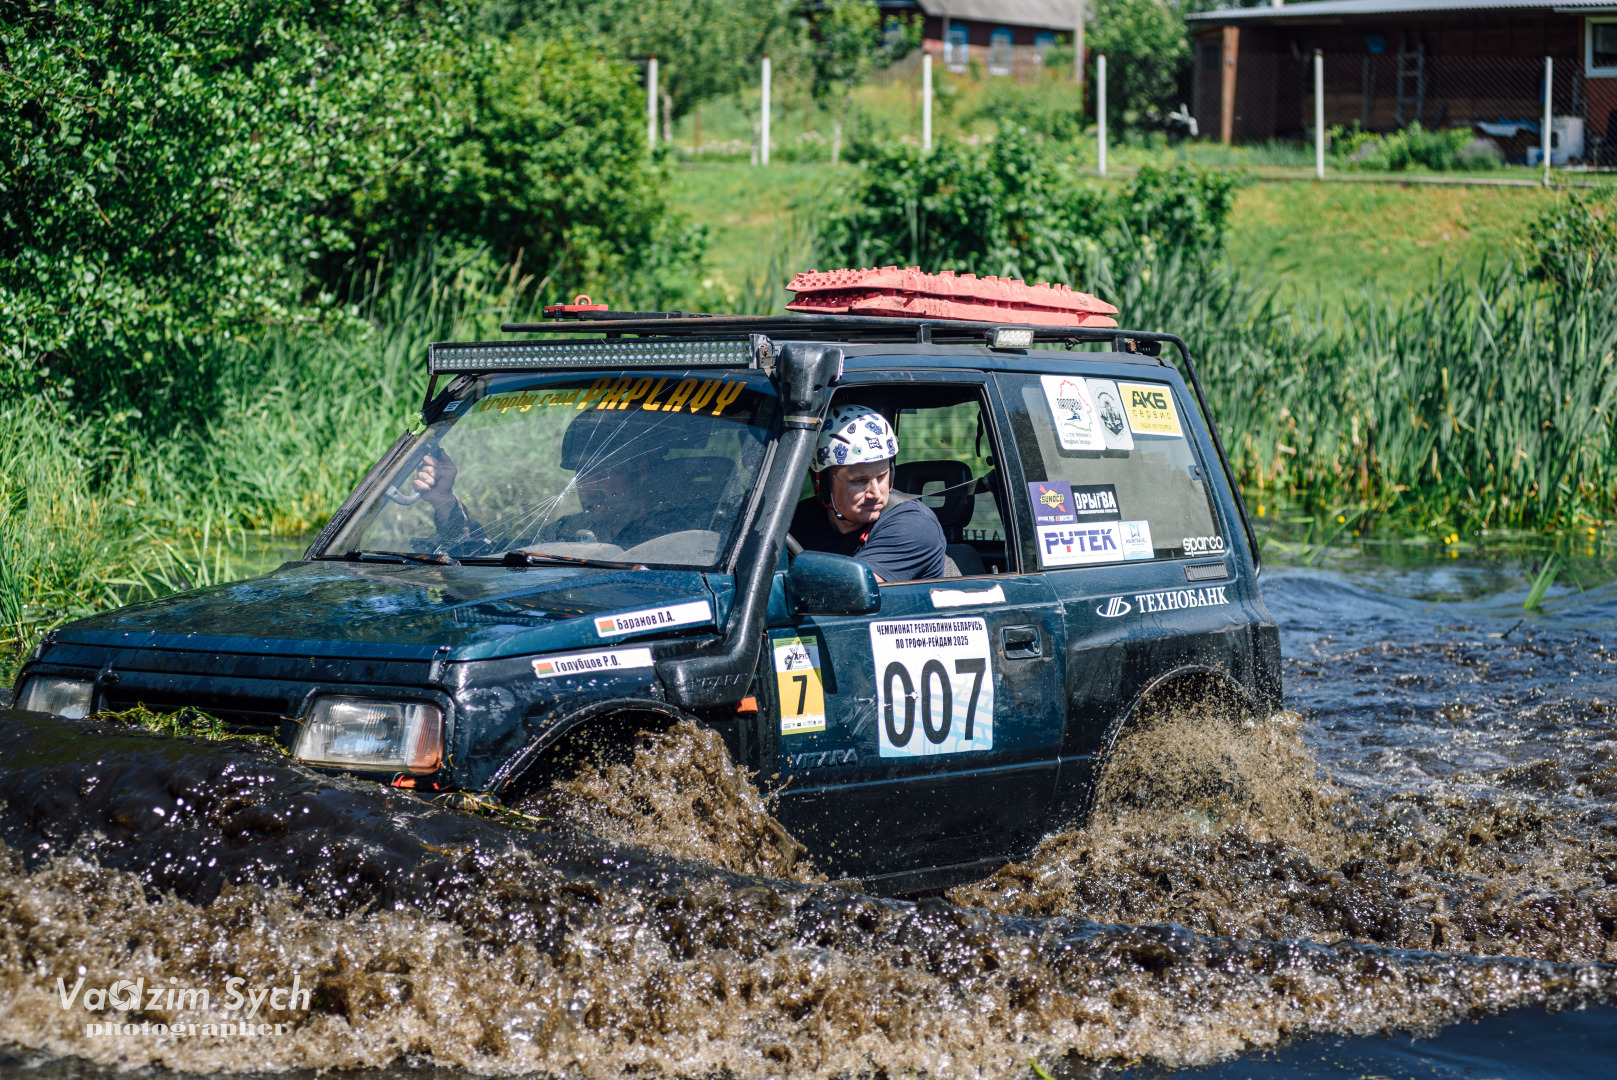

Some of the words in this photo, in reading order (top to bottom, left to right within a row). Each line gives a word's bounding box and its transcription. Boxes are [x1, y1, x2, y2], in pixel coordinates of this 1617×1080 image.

[480, 392, 536, 414] trophy
[537, 388, 583, 406] raid
[576, 376, 748, 416] PAPLAVY
[1132, 390, 1168, 410] АКБ
[1132, 409, 1172, 420] сервис
[1041, 495, 1064, 504] SUNOCO
[1182, 536, 1224, 557] sparco
[1135, 586, 1230, 613] ТЕХНОБАНК
[616, 614, 657, 630] Баранов
[658, 610, 676, 624] П.А.
[876, 623, 914, 635] ЧЕМПИОНАТ
[914, 621, 953, 634] РЕСПУБЛИКИ
[953, 620, 983, 632] БЕЛАРУСЬ
[895, 638, 905, 649] ПО
[905, 635, 953, 649] ТРОФИ-РЕЙДАМ
[953, 635, 969, 646] 2025
[554, 656, 602, 673] Голубцов
[602, 654, 621, 667] Р.О.
[792, 674, 808, 715] 7
[883, 657, 987, 748] 007
[790, 748, 858, 769] VITARA
